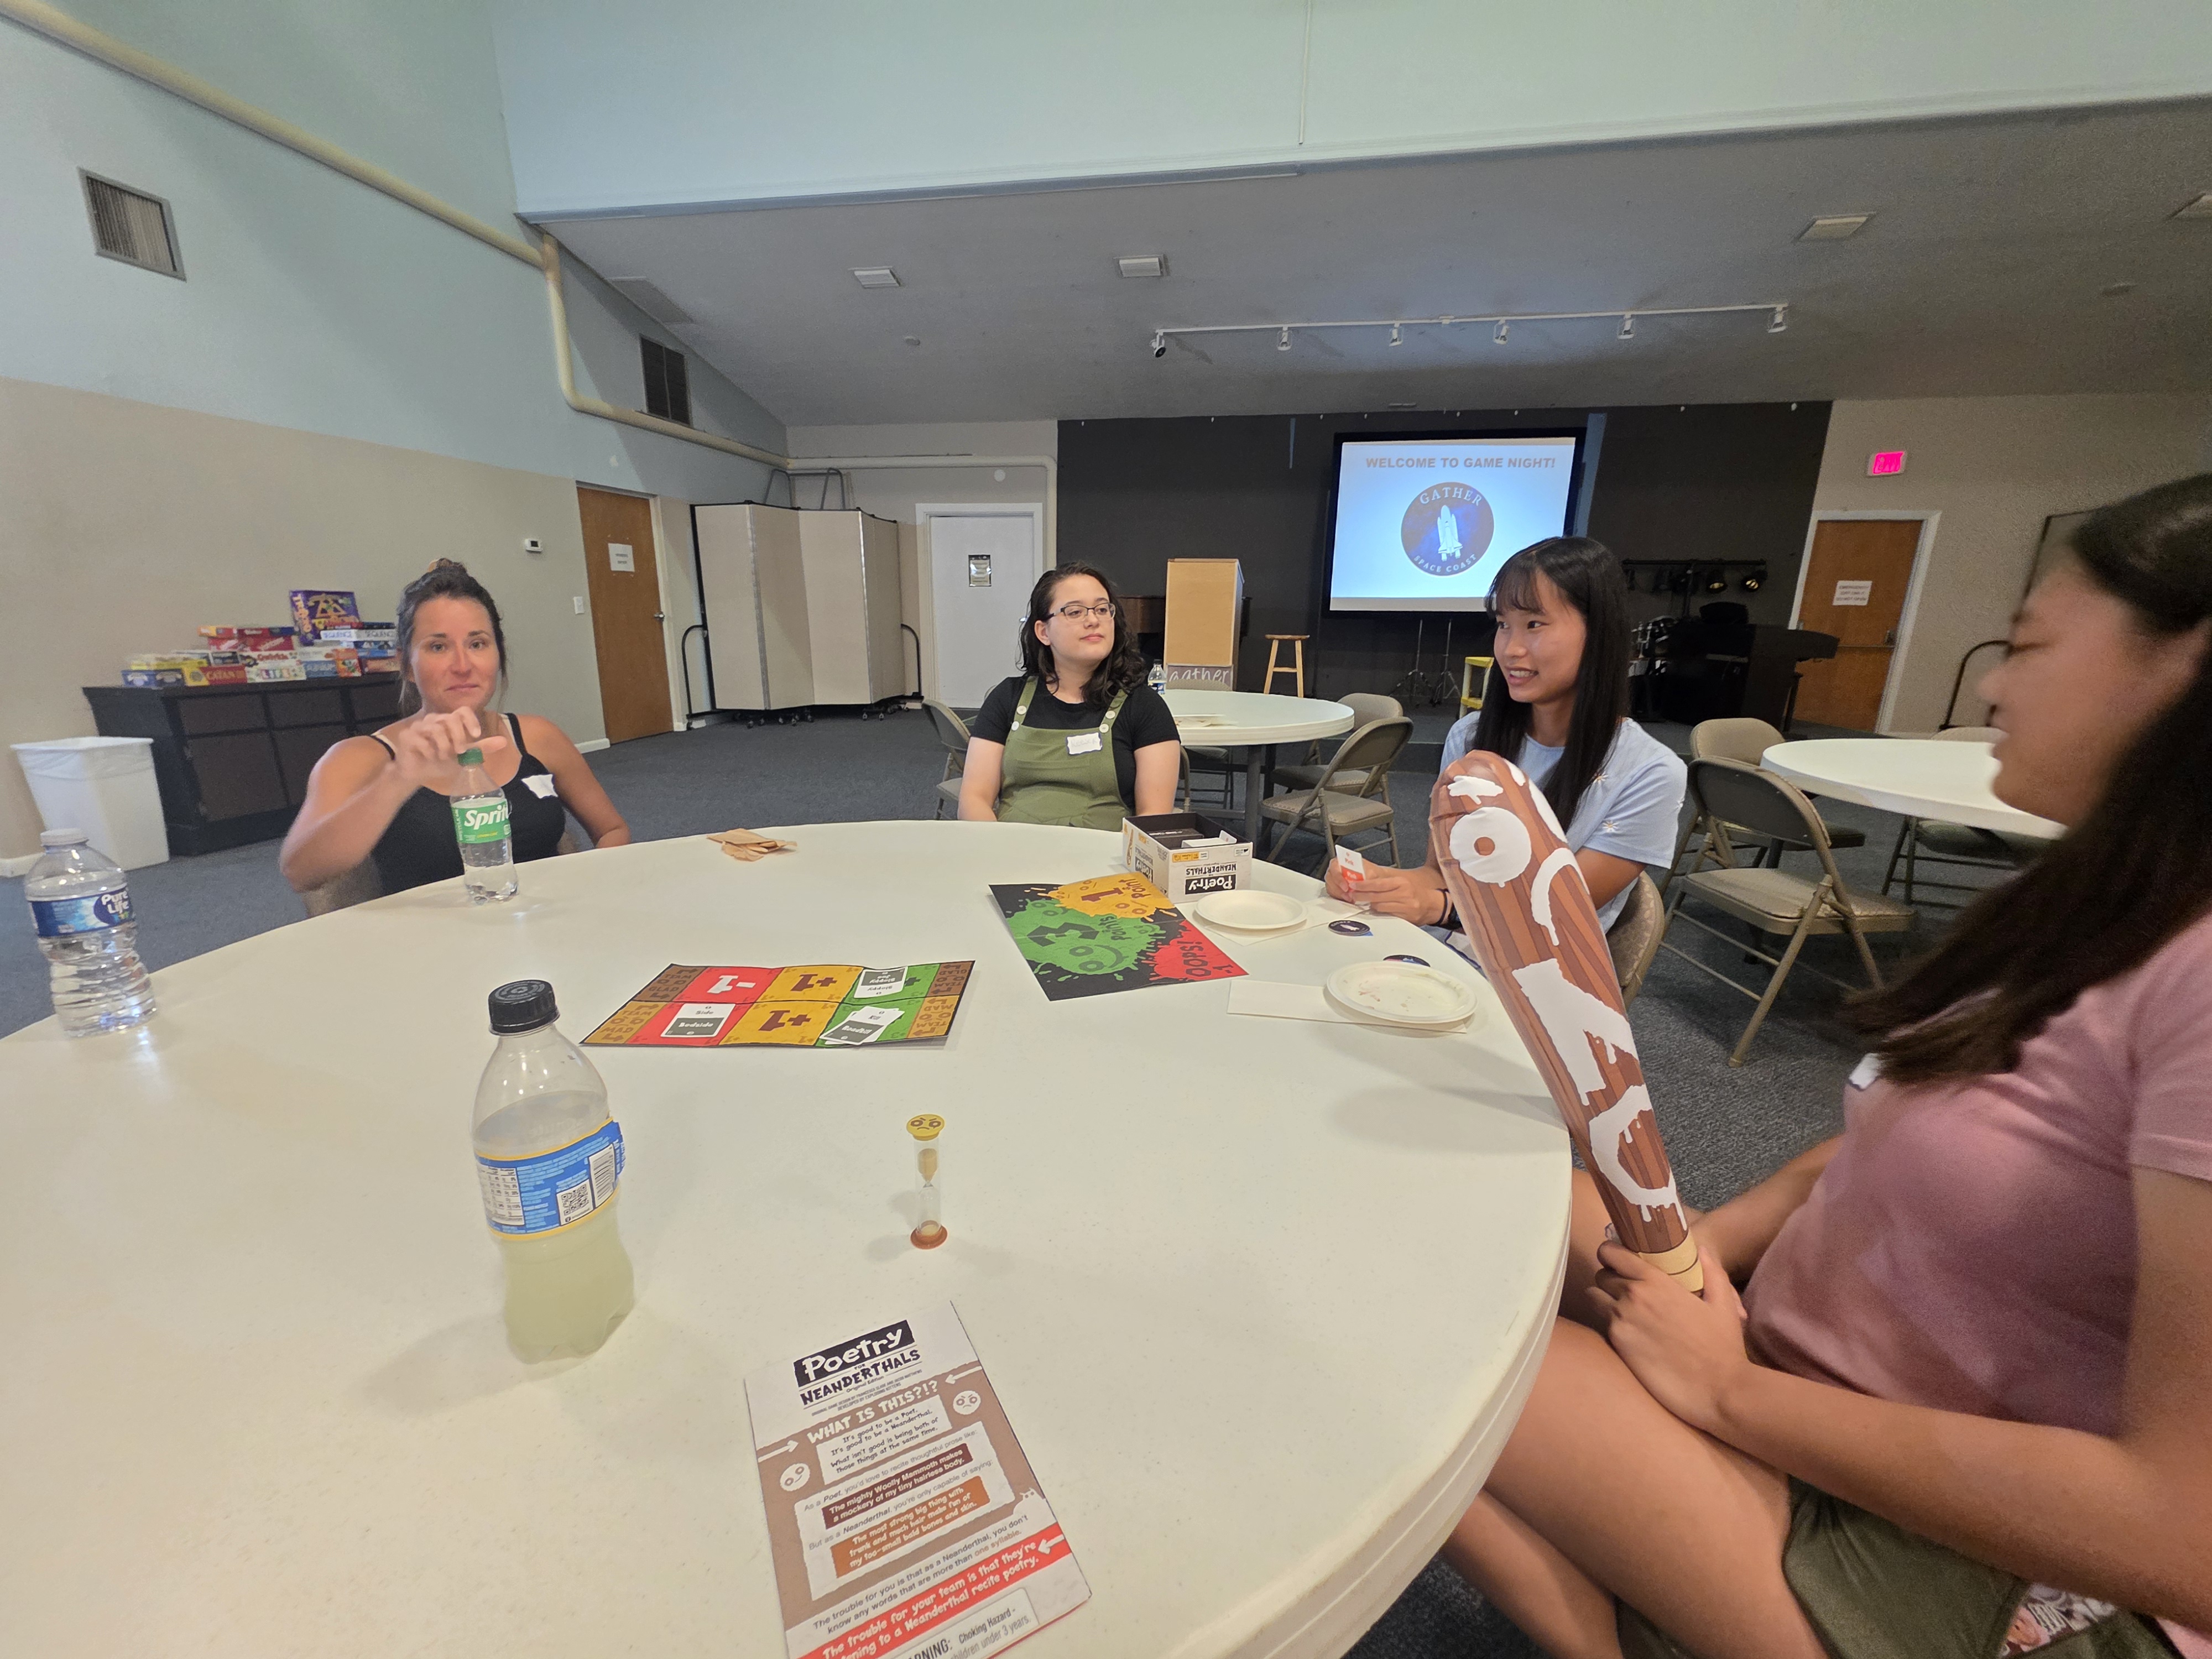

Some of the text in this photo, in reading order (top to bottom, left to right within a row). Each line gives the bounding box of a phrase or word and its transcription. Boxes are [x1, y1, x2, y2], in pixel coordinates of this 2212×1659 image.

[1366, 458, 1556, 468] WELCOME TO GAME NIGHT!
[1420, 487, 1482, 506] GATHER
[1414, 554, 1477, 572] SPACE COAST
[464, 804, 509, 830] Sprit
[1186, 864, 1237, 875] NEANDERTHALS
[1188, 875, 1233, 890] Poetry
[101, 890, 128, 905] Pure
[107, 900, 129, 914] Life
[841, 1025, 873, 1035] Roadkill
[800, 1349, 920, 1405] NEANDERTHALS
[802, 1329, 902, 1381] Poetry
[807, 1415, 851, 1443] WHAT
[855, 1407, 875, 1423] IS
[878, 1380, 937, 1412] THIS?!?
[831, 1447, 843, 1455] It's
[846, 1437, 862, 1451] good
[890, 1409, 932, 1430] Neanderthal.
[857, 1425, 873, 1438] good
[901, 1408, 917, 1418] Poet.
[823, 1490, 843, 1503] Poet,
[844, 1479, 864, 1494] you'd
[865, 1473, 880, 1483] love
[890, 1460, 909, 1472] recite
[910, 1444, 943, 1463] thoughtful
[944, 1437, 963, 1448] prose
[963, 1429, 978, 1438] like:
[830, 1455, 849, 1467] What
[852, 1448, 865, 1458] isn't
[868, 1439, 885, 1453] good
[894, 1429, 913, 1439] being
[914, 1421, 929, 1431] both
[836, 1462, 854, 1473] those
[857, 1452, 878, 1464] things
[902, 1434, 919, 1444] same
[921, 1427, 938, 1436] time.
[829, 1449, 963, 1514] The mighty Woolly Mammoth makes
[840, 1499, 874, 1519] mockery
[875, 1493, 884, 1502] of
[885, 1488, 896, 1498] my
[898, 1481, 912, 1491] tiny
[914, 1467, 943, 1484] hairless
[943, 1458, 964, 1470] body.
[849, 1542, 871, 1557] trunk
[872, 1532, 887, 1546] and
[909, 1515, 925, 1527] hair
[927, 1505, 946, 1519] make
[948, 1498, 961, 1508] fun
[962, 1492, 971, 1501] of
[849, 1556, 862, 1567] my
[921, 1517, 943, 1532] bones
[945, 1507, 958, 1520] and
[852, 1487, 964, 1545] The most strong big thing with
[813, 1617, 830, 1629] The
[832, 1600, 863, 1619] trouble
[865, 1592, 877, 1602] for
[879, 1583, 895, 1597] you
[906, 1568, 922, 1581] that
[925, 1563, 934, 1572] as
[942, 1533, 992, 1562] Neanderthal,
[992, 1525, 1007, 1537] you
[1008, 1515, 1028, 1528] don't
[827, 1530, 1021, 1634] know any words that are more than one syllable.
[823, 1538, 1038, 1659] The trouble for your team is that they're
[879, 1553, 1041, 1645] to a Neanderthal recite poetry.
[958, 1623, 988, 1644] Choking
[987, 1608, 1011, 1627] Hazard
[981, 1631, 1002, 1648] under
[1002, 1624, 1009, 1636] 3
[1009, 1615, 1031, 1635] years.
